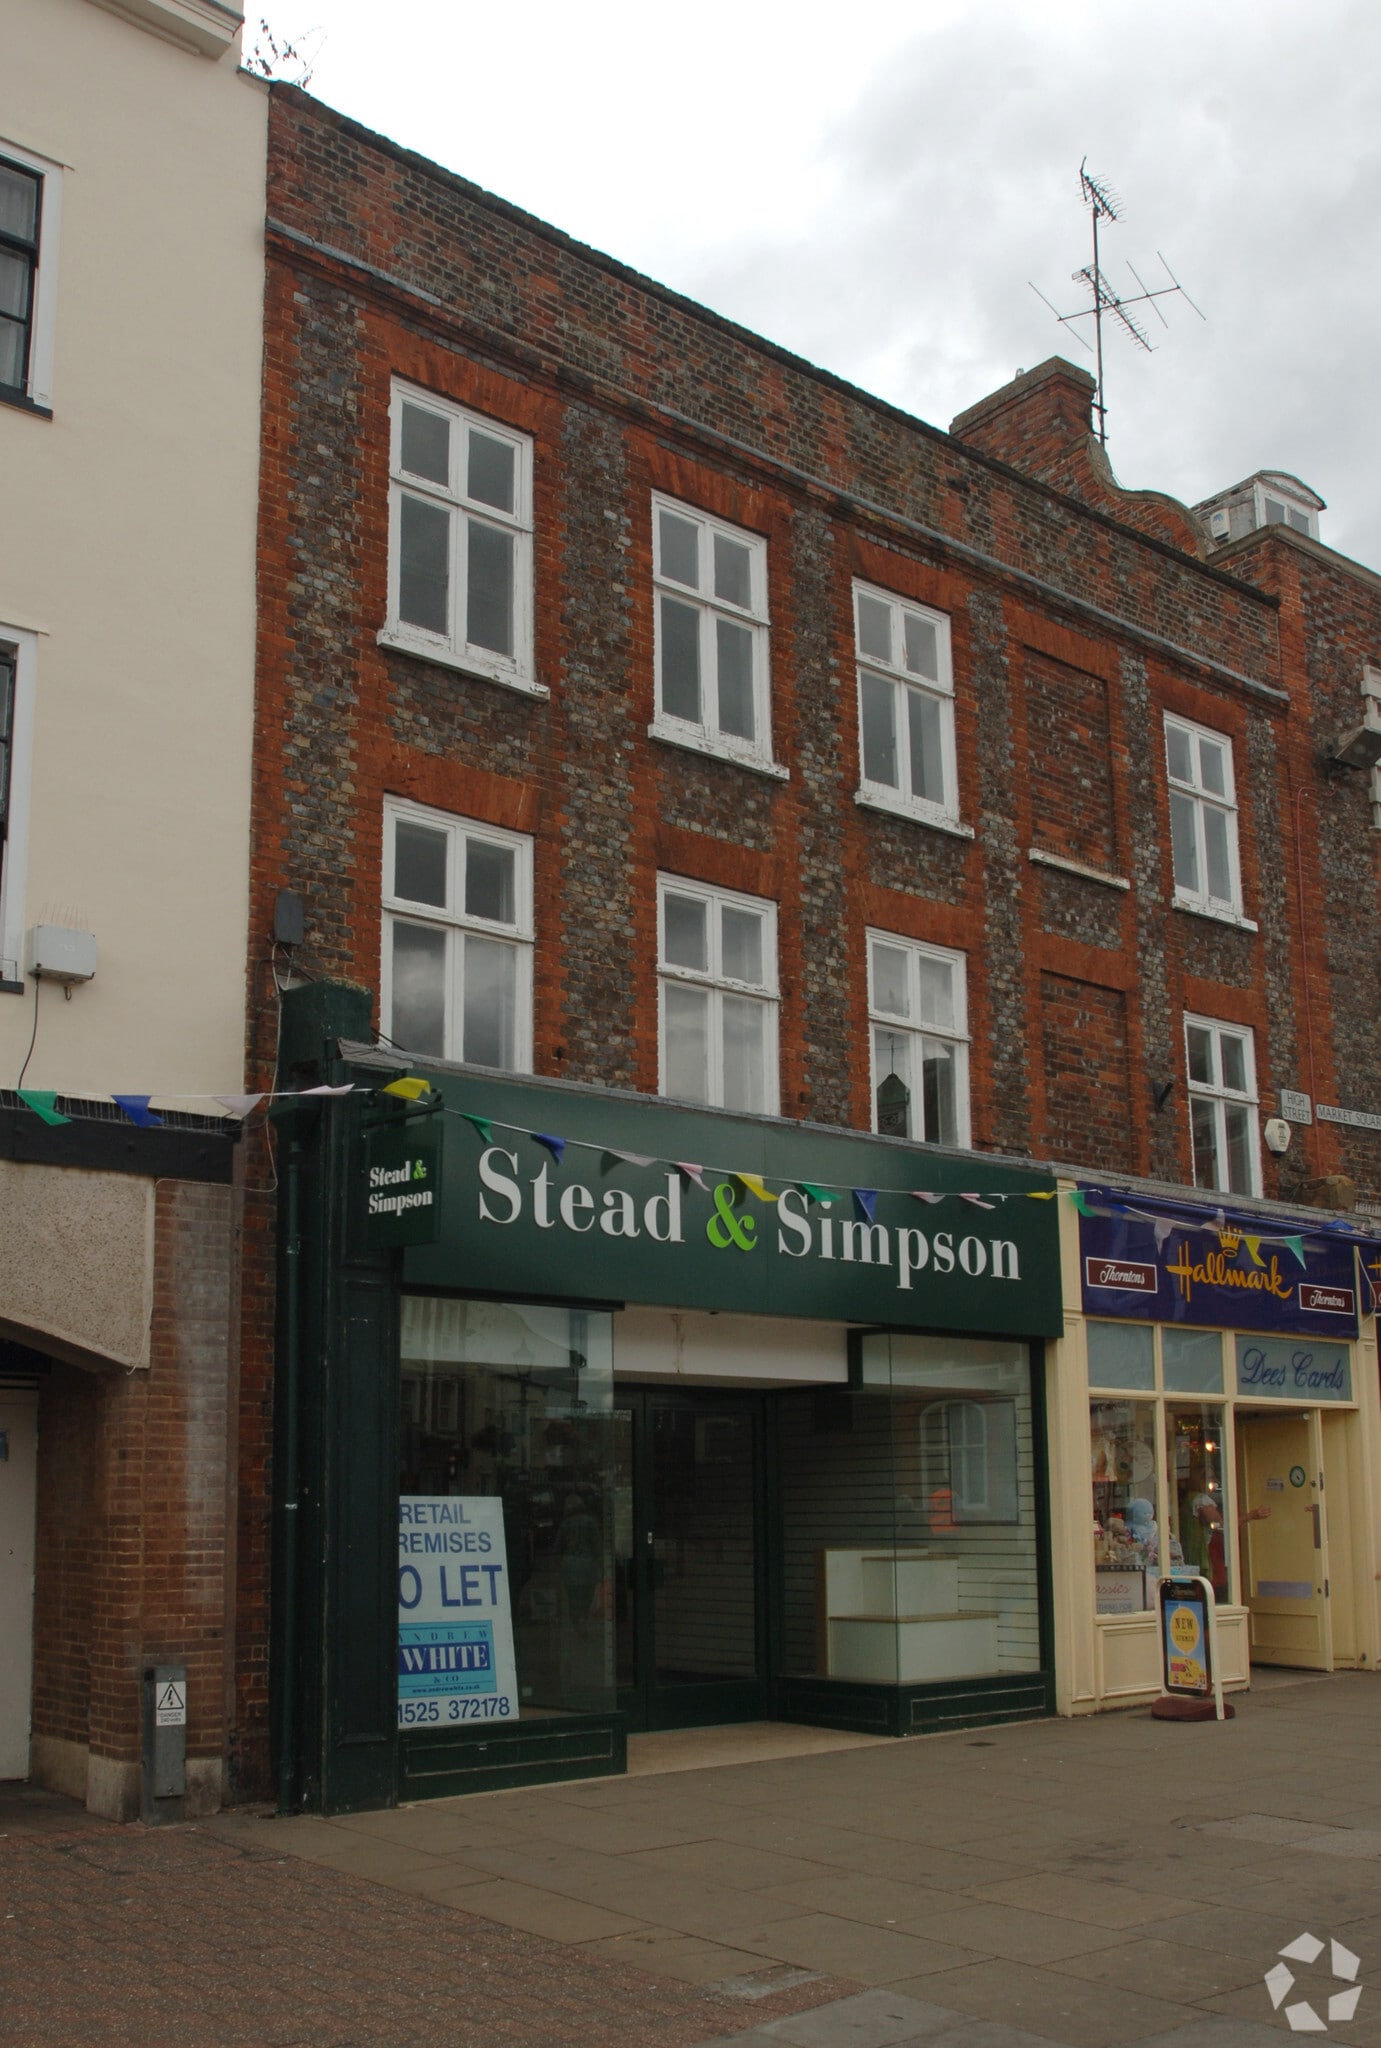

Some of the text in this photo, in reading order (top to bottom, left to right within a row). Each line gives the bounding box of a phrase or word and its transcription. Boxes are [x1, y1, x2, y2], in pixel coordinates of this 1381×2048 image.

[1287, 1091, 1304, 1106] HIGH
[1283, 1106, 1310, 1122] STREET
[1318, 1106, 1381, 1128] MARKET SQUAR
[369, 1159, 427, 1188] Stead &
[368, 1190, 433, 1216] Simpson
[478, 1147, 1022, 1290] Stead & Simpson
[1099, 1264, 1145, 1285] Thorntons
[1165, 1240, 1293, 1302] Hallmark
[1309, 1289, 1345, 1308] Thorntons
[1241, 1348, 1344, 1390] Dees Cards
[399, 1504, 471, 1524] RETAIL
[399, 1532, 492, 1553] REMISES
[399, 1565, 503, 1609] O LET
[1096, 1582, 1130, 1594] assics
[1175, 1617, 1193, 1630] NEW
[402, 1644, 488, 1671] WHITE
[398, 1697, 510, 1722] 1525 372178
